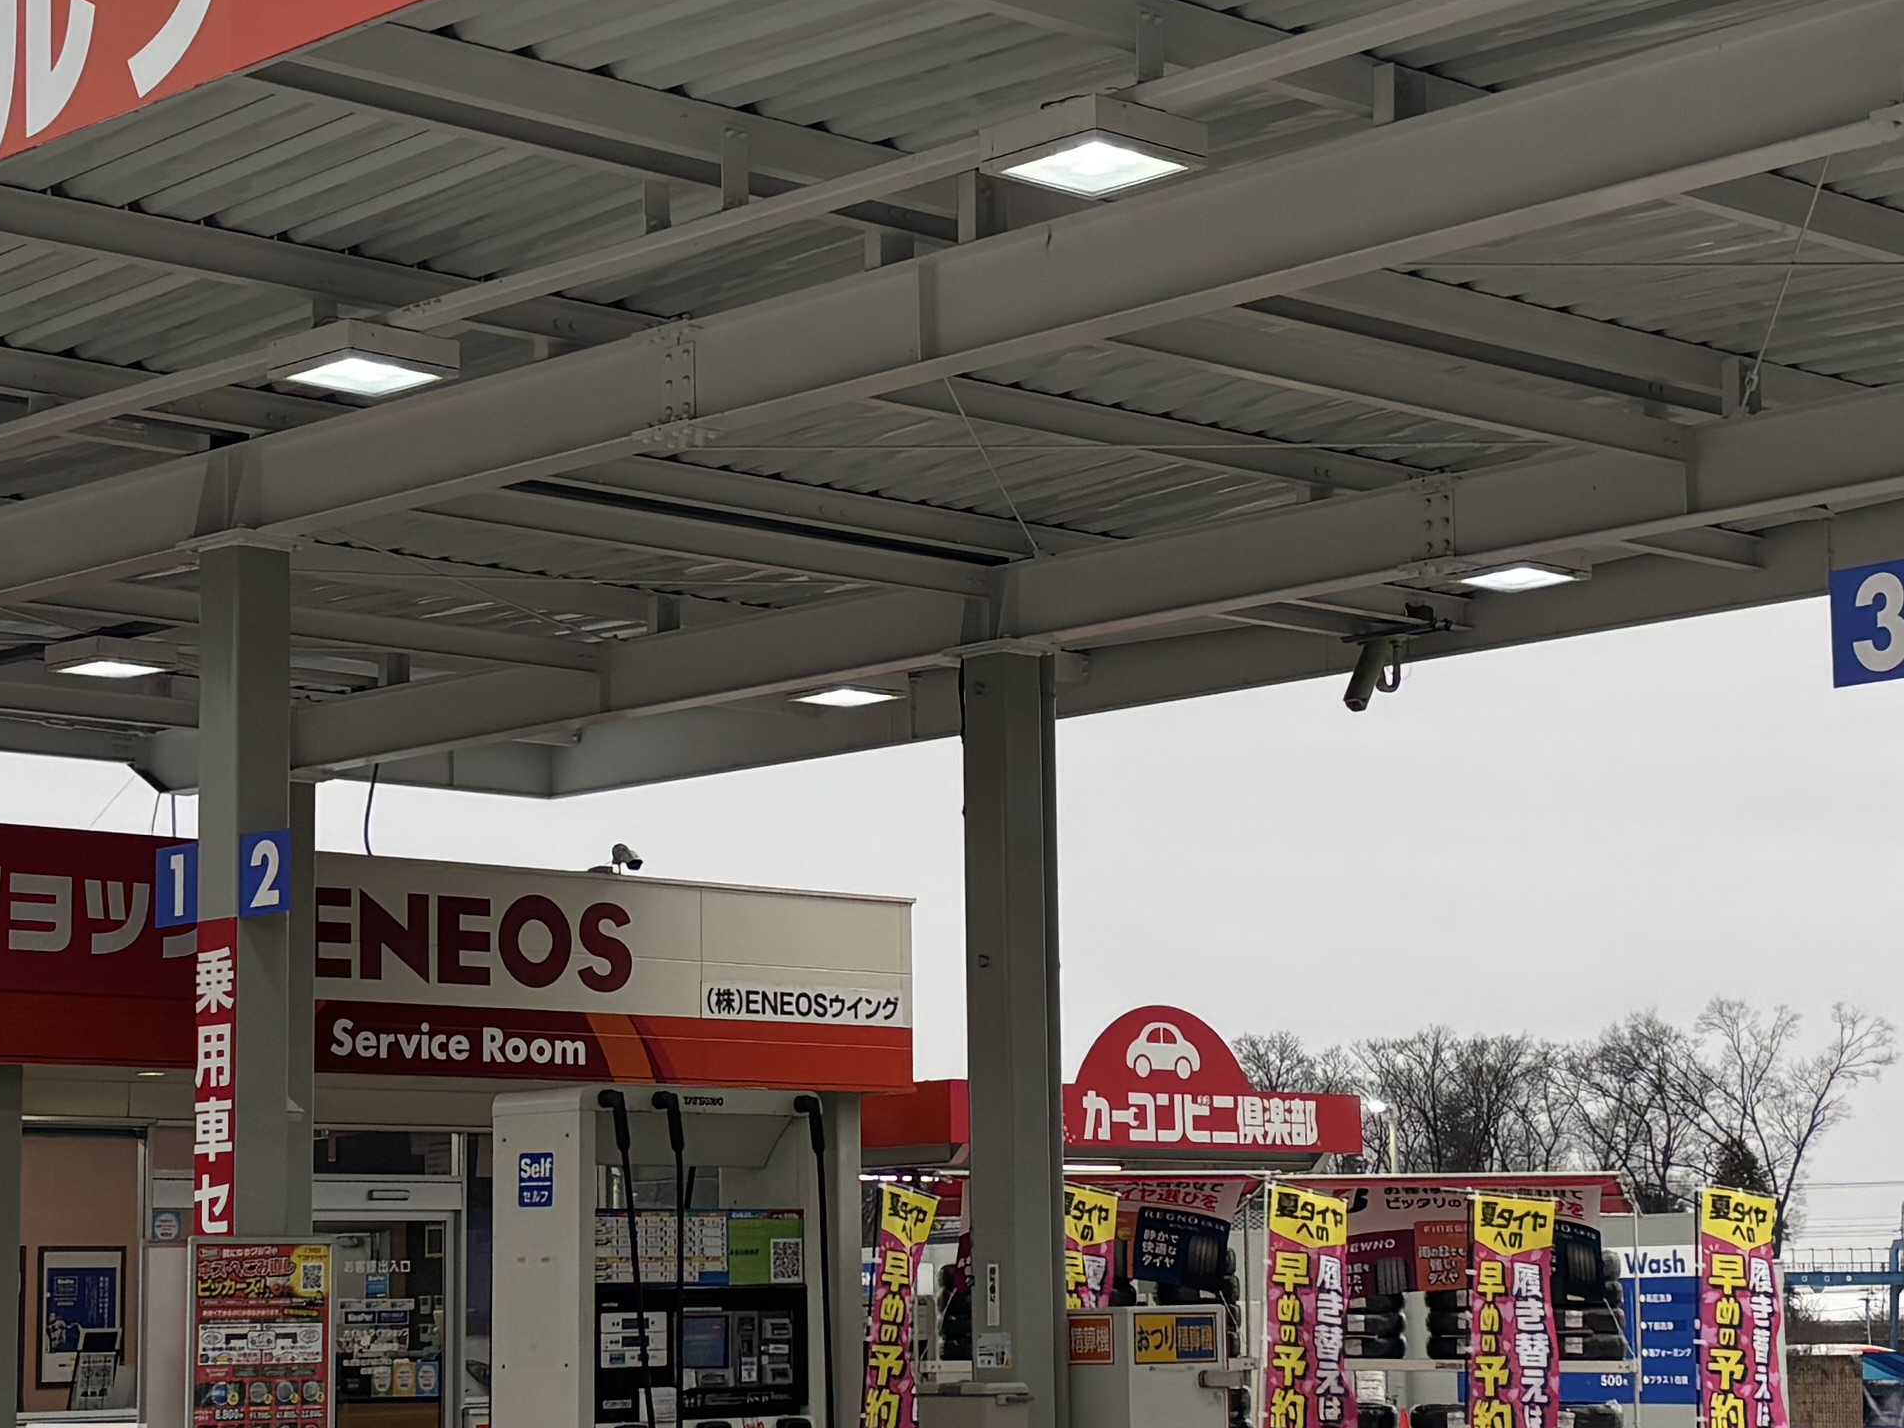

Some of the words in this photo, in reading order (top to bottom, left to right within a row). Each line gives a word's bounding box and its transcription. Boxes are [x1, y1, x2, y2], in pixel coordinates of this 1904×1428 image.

[169, 853, 185, 917] 1
[249, 838, 281, 909] 2
[315, 886, 633, 993] ENEOS
[330, 1018, 471, 1062] Service
[482, 1026, 587, 1066] Room
[1081, 1090, 1318, 1146] カーコンビニ倶楽部
[520, 1156, 553, 1179] Self
[522, 1189, 549, 1203] セルフ
[1275, 1192, 1344, 1228] 夏タイヤ
[1710, 1193, 1768, 1228] 夏タイヤ
[1144, 1209, 1199, 1225] REGNO
[1480, 1200, 1548, 1233] 夏タイヤ
[1296, 1222, 1329, 1242] への
[1493, 1231, 1523, 1249] への
[1141, 1254, 1176, 1269] タイヤ
[1623, 1248, 1686, 1275] Wash
[1428, 1270, 1459, 1285] タイヤ
